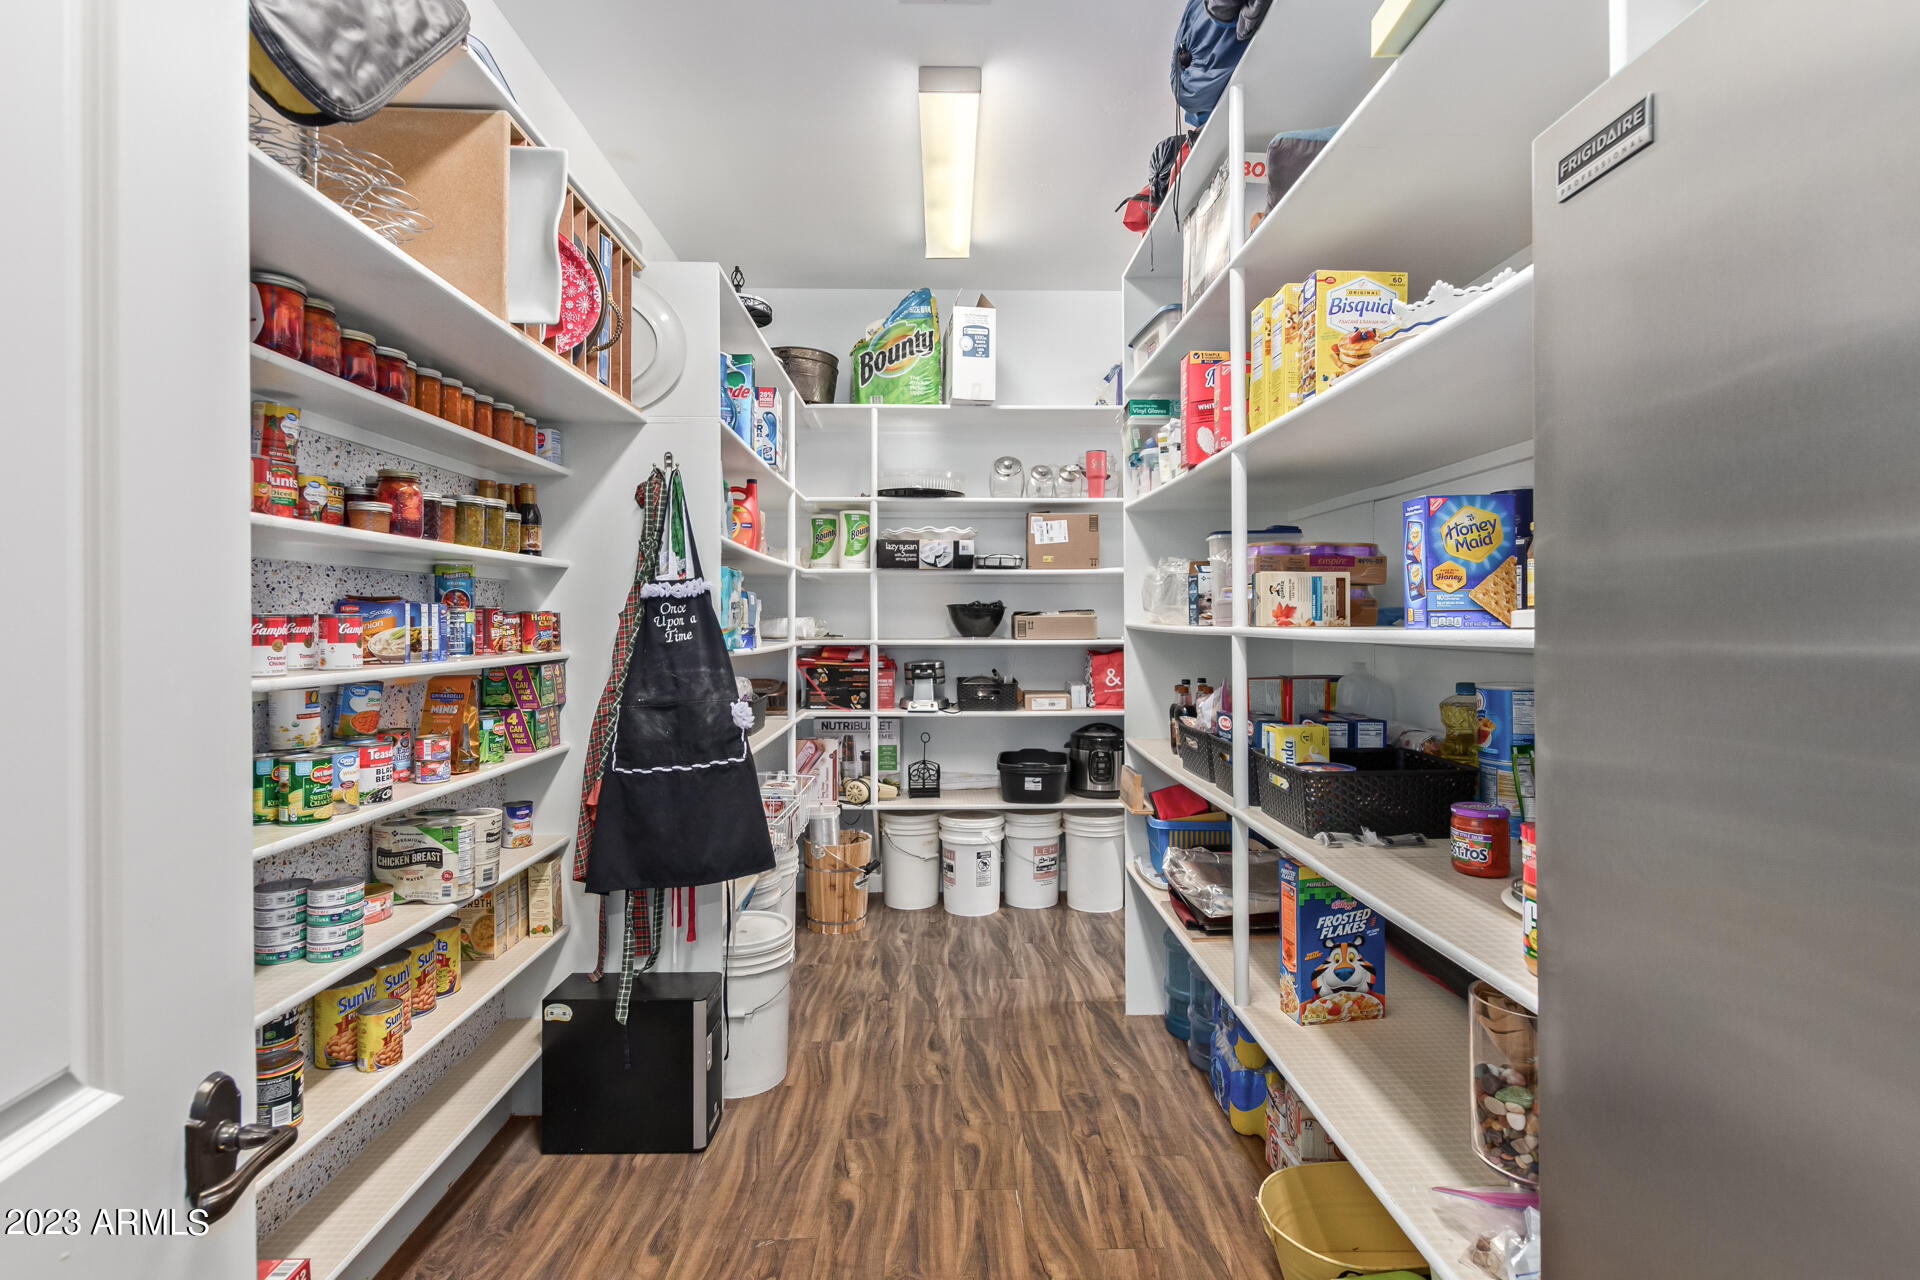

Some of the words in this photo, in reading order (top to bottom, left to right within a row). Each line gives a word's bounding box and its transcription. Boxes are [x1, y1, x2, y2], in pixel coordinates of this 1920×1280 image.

[1560, 106, 1644, 178] FRIGIDAIRE
[1243, 161, 1266, 178] BO
[1561, 135, 1644, 196] PROFESSIONAL
[1328, 298, 1396, 318] Bisquick
[859, 330, 935, 387] Bounty
[1447, 518, 1498, 541] Honey
[885, 542, 898, 551] lazy
[898, 543, 918, 551] susan
[1454, 532, 1494, 553] Maid
[660, 602, 687, 615] Once
[653, 615, 685, 631] Upon
[689, 615, 697, 624] a
[664, 628, 693, 643] Time
[513, 669, 524, 681] 4
[507, 712, 518, 725] 4
[377, 853, 410, 867] CHICKEN
[411, 851, 441, 863] BREAST
[1316, 908, 1372, 930] FROSTED
[1319, 920, 1367, 940] FLAKES
